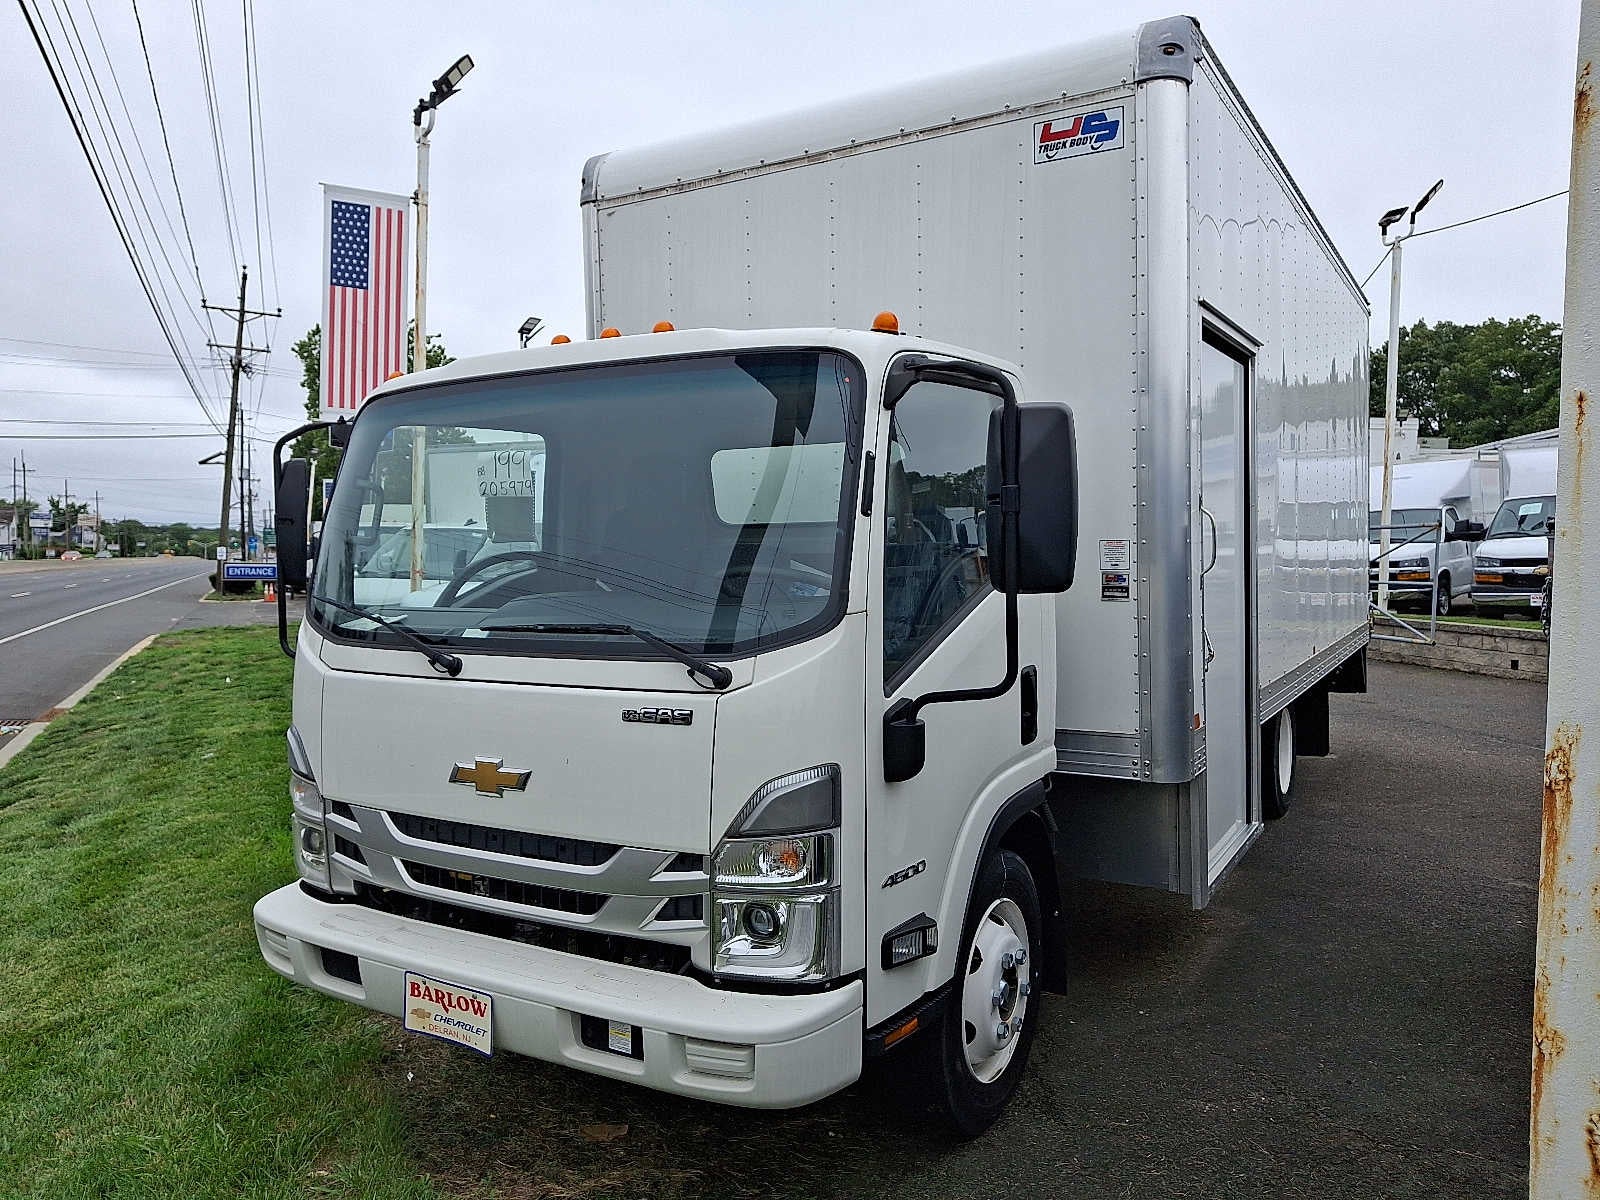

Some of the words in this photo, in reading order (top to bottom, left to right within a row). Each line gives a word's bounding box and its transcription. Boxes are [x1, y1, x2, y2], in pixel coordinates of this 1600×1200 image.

[1040, 112, 1120, 144] US
[1038, 139, 1067, 155] TRUCK
[1069, 134, 1097, 149] BODY
[494, 450, 526, 479] 199
[479, 480, 533, 497] 205979
[228, 567, 274, 576] ENTRANCE
[640, 708, 693, 726] GAS
[881, 859, 926, 889] 4500
[409, 981, 488, 1018] BARLOW
[433, 1013, 487, 1037] CHEVROLET
[462, 1032, 472, 1043] NJ
